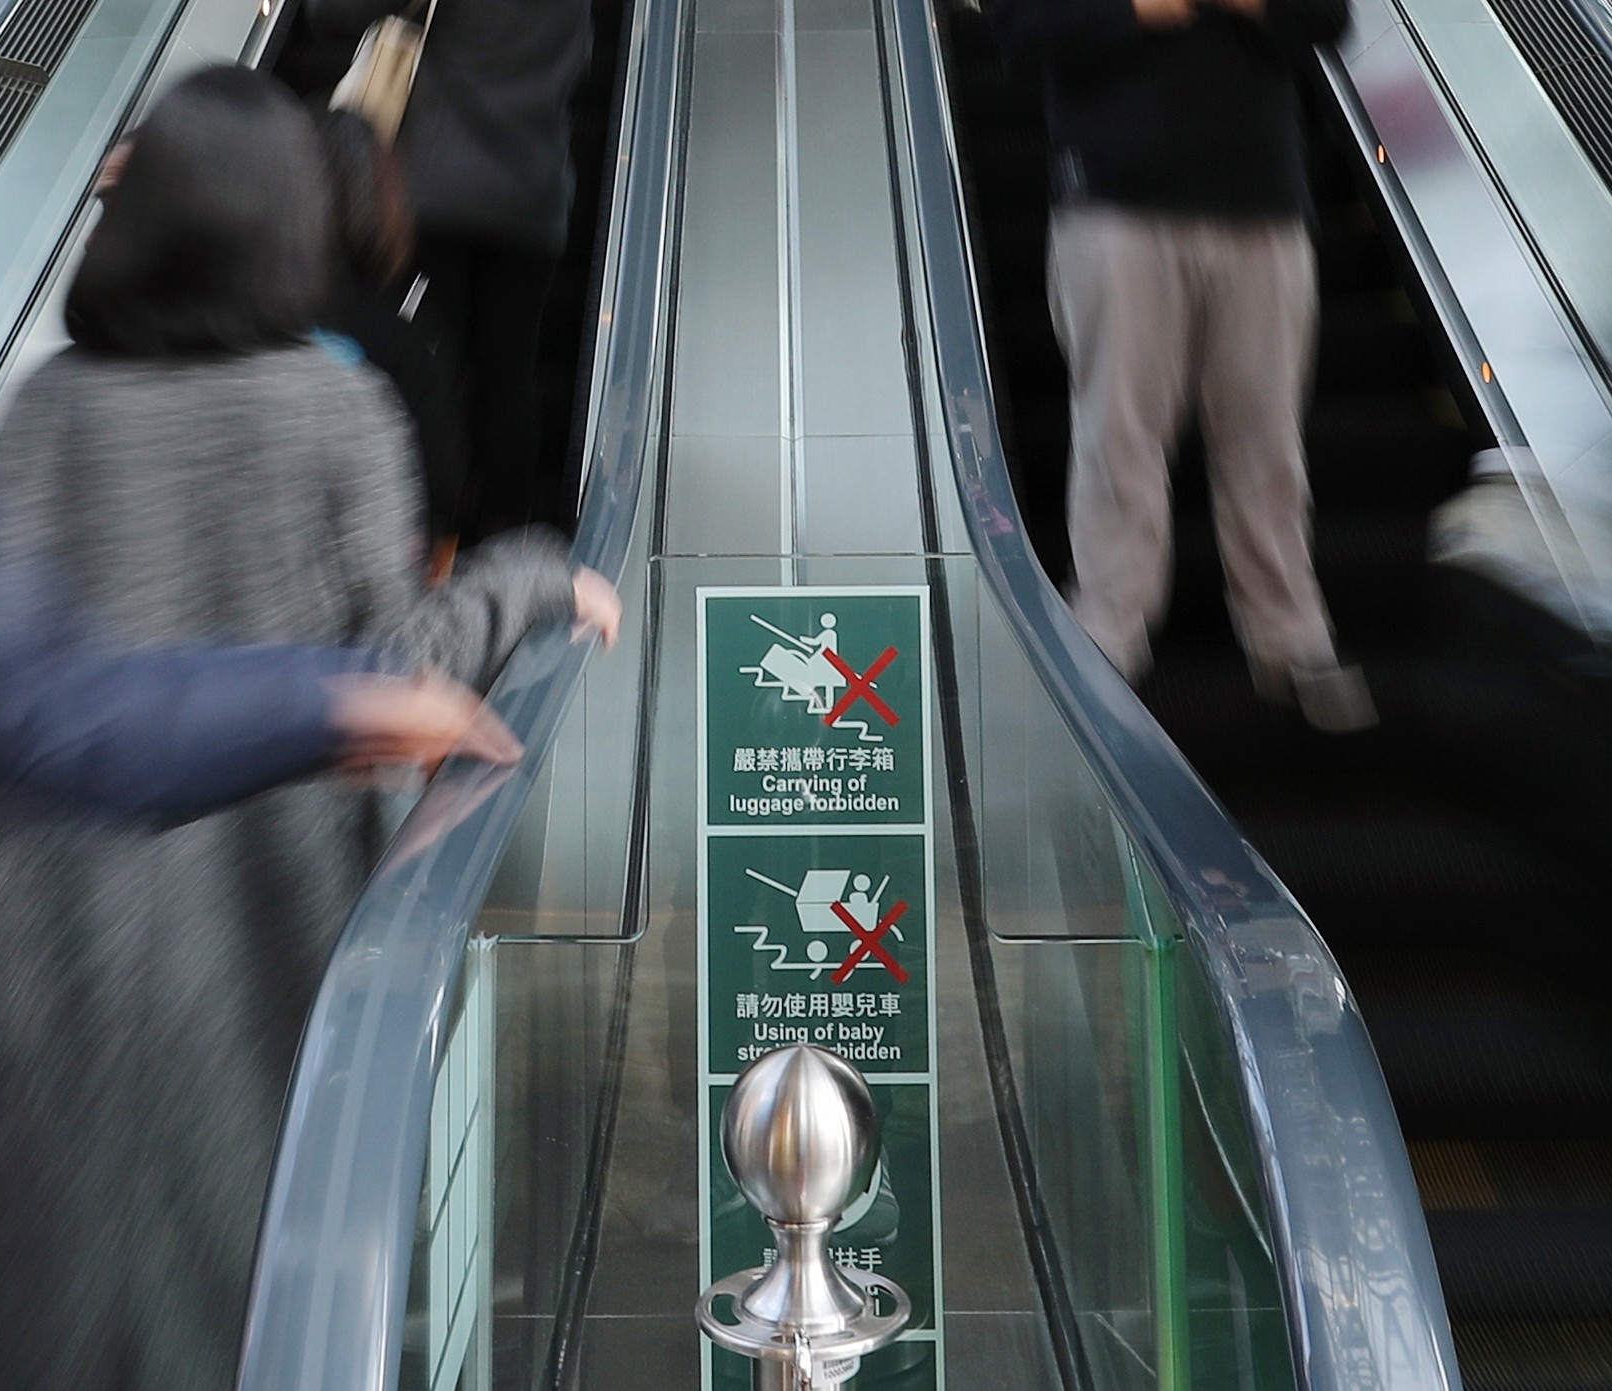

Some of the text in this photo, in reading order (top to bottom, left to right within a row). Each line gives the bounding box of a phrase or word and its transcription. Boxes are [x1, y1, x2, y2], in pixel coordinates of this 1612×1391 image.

[733, 746, 895, 772] 嚴禁攜帶行李箱
[762, 774, 867, 795] Carrying of
[729, 793, 900, 816] luggage forbidden
[736, 993, 902, 1019] 請勿使用嬰兒車
[753, 1022, 885, 1044] Using of baby
